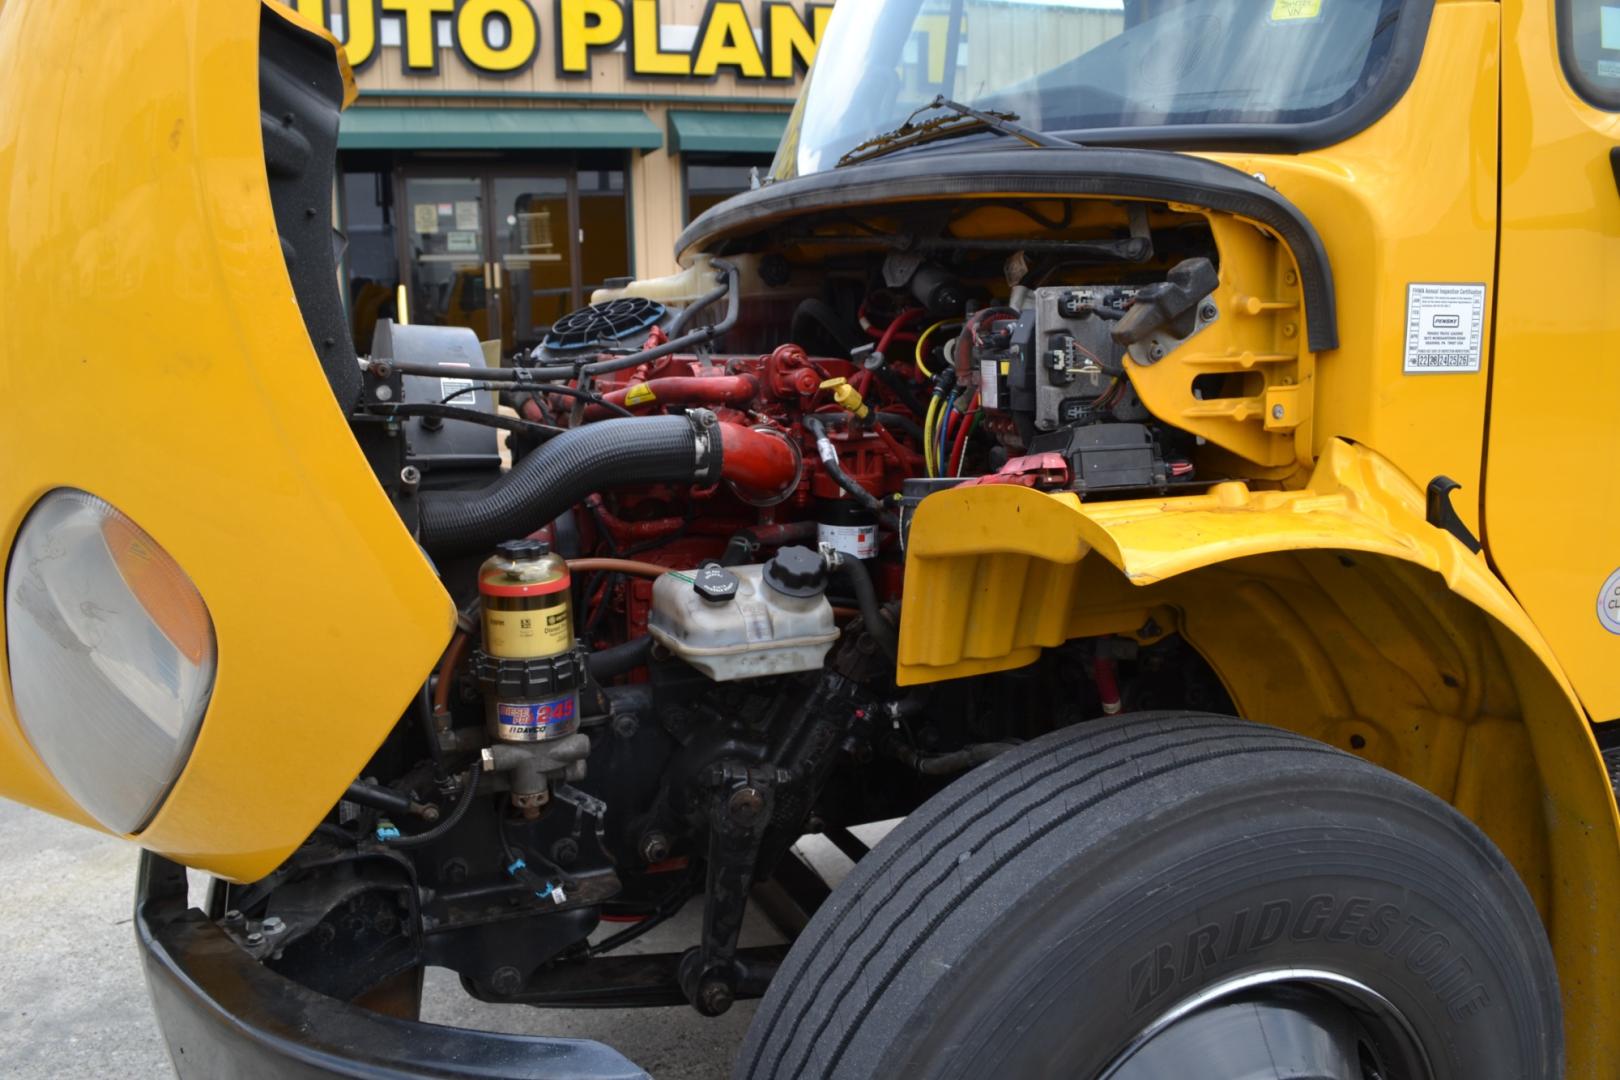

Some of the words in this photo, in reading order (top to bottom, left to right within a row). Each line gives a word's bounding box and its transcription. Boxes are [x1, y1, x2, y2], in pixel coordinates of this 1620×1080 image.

[1419, 355, 1428, 365] 22
[1439, 355, 1448, 365] 24
[1449, 355, 1458, 365] 25
[1459, 355, 1467, 365] 26
[537, 699, 574, 723] 245
[1128, 894, 1490, 1022] BRIDGESTONE
